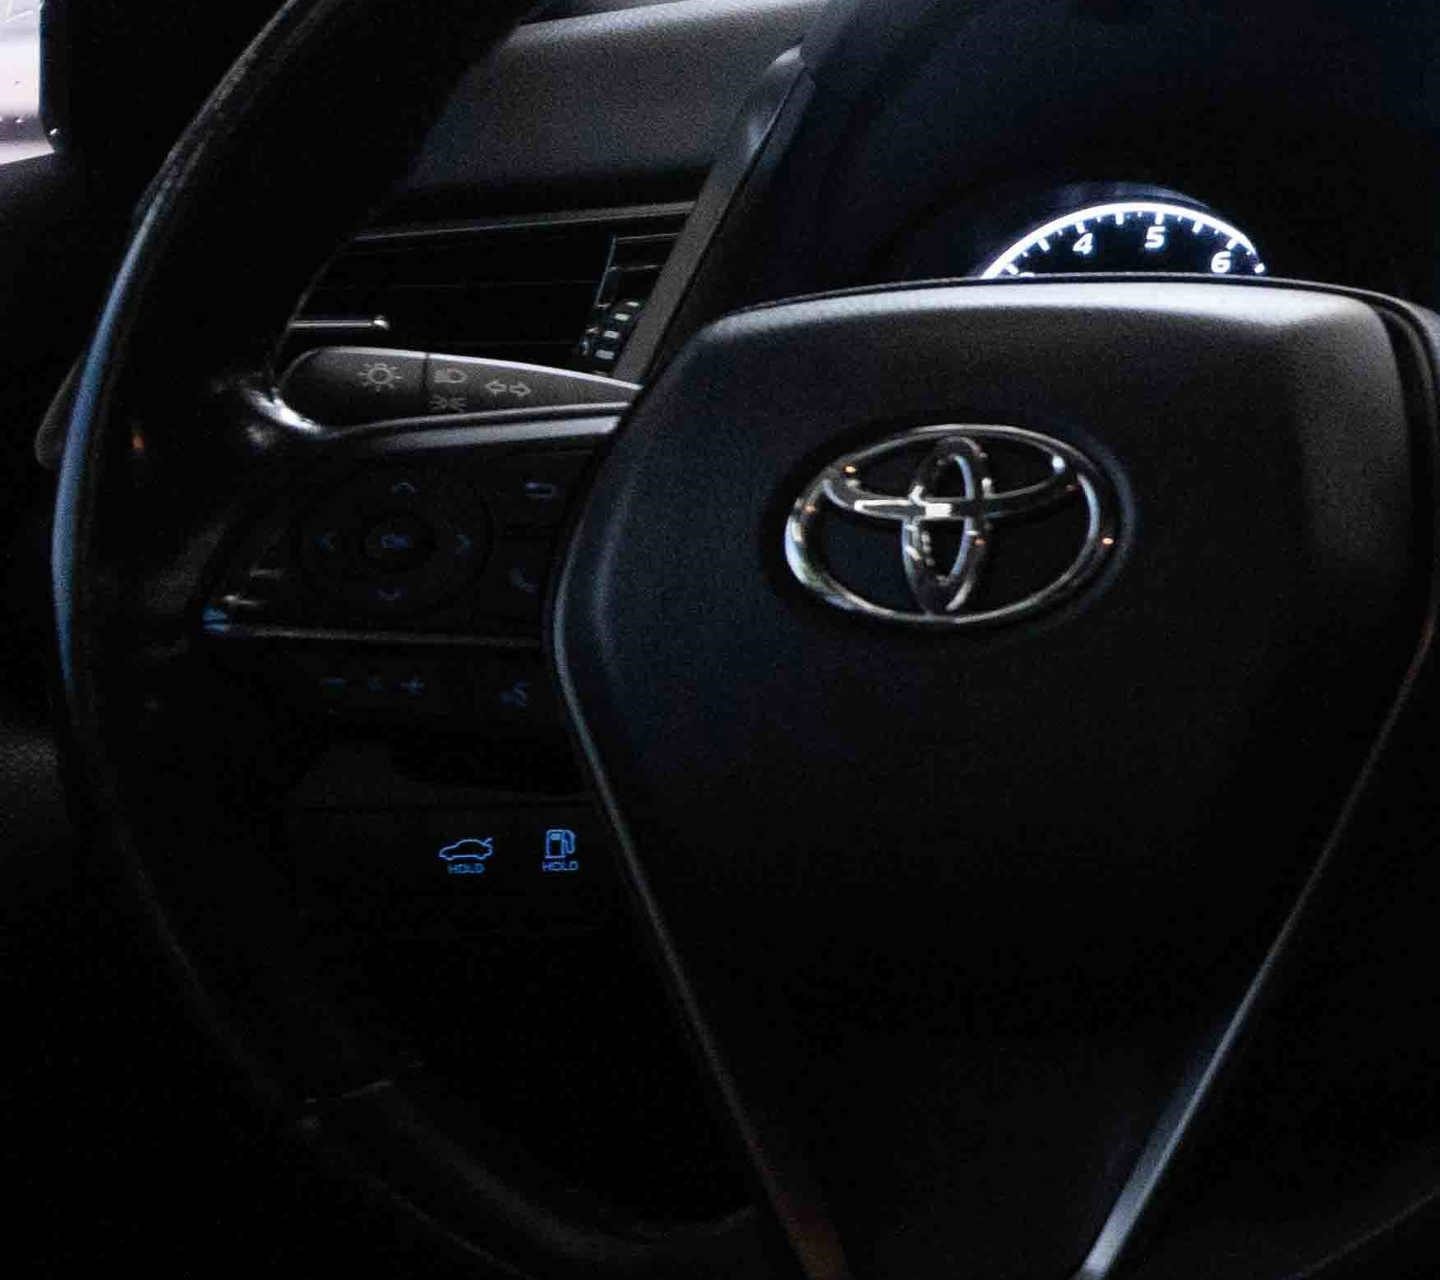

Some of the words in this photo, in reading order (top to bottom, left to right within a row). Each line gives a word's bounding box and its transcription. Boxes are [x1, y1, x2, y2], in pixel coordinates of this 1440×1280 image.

[1072, 232, 1094, 255] 4
[1144, 225, 1167, 250] 5
[1210, 250, 1232, 274] 6
[447, 862, 486, 876] HOLD
[541, 858, 579, 873] HOLD
